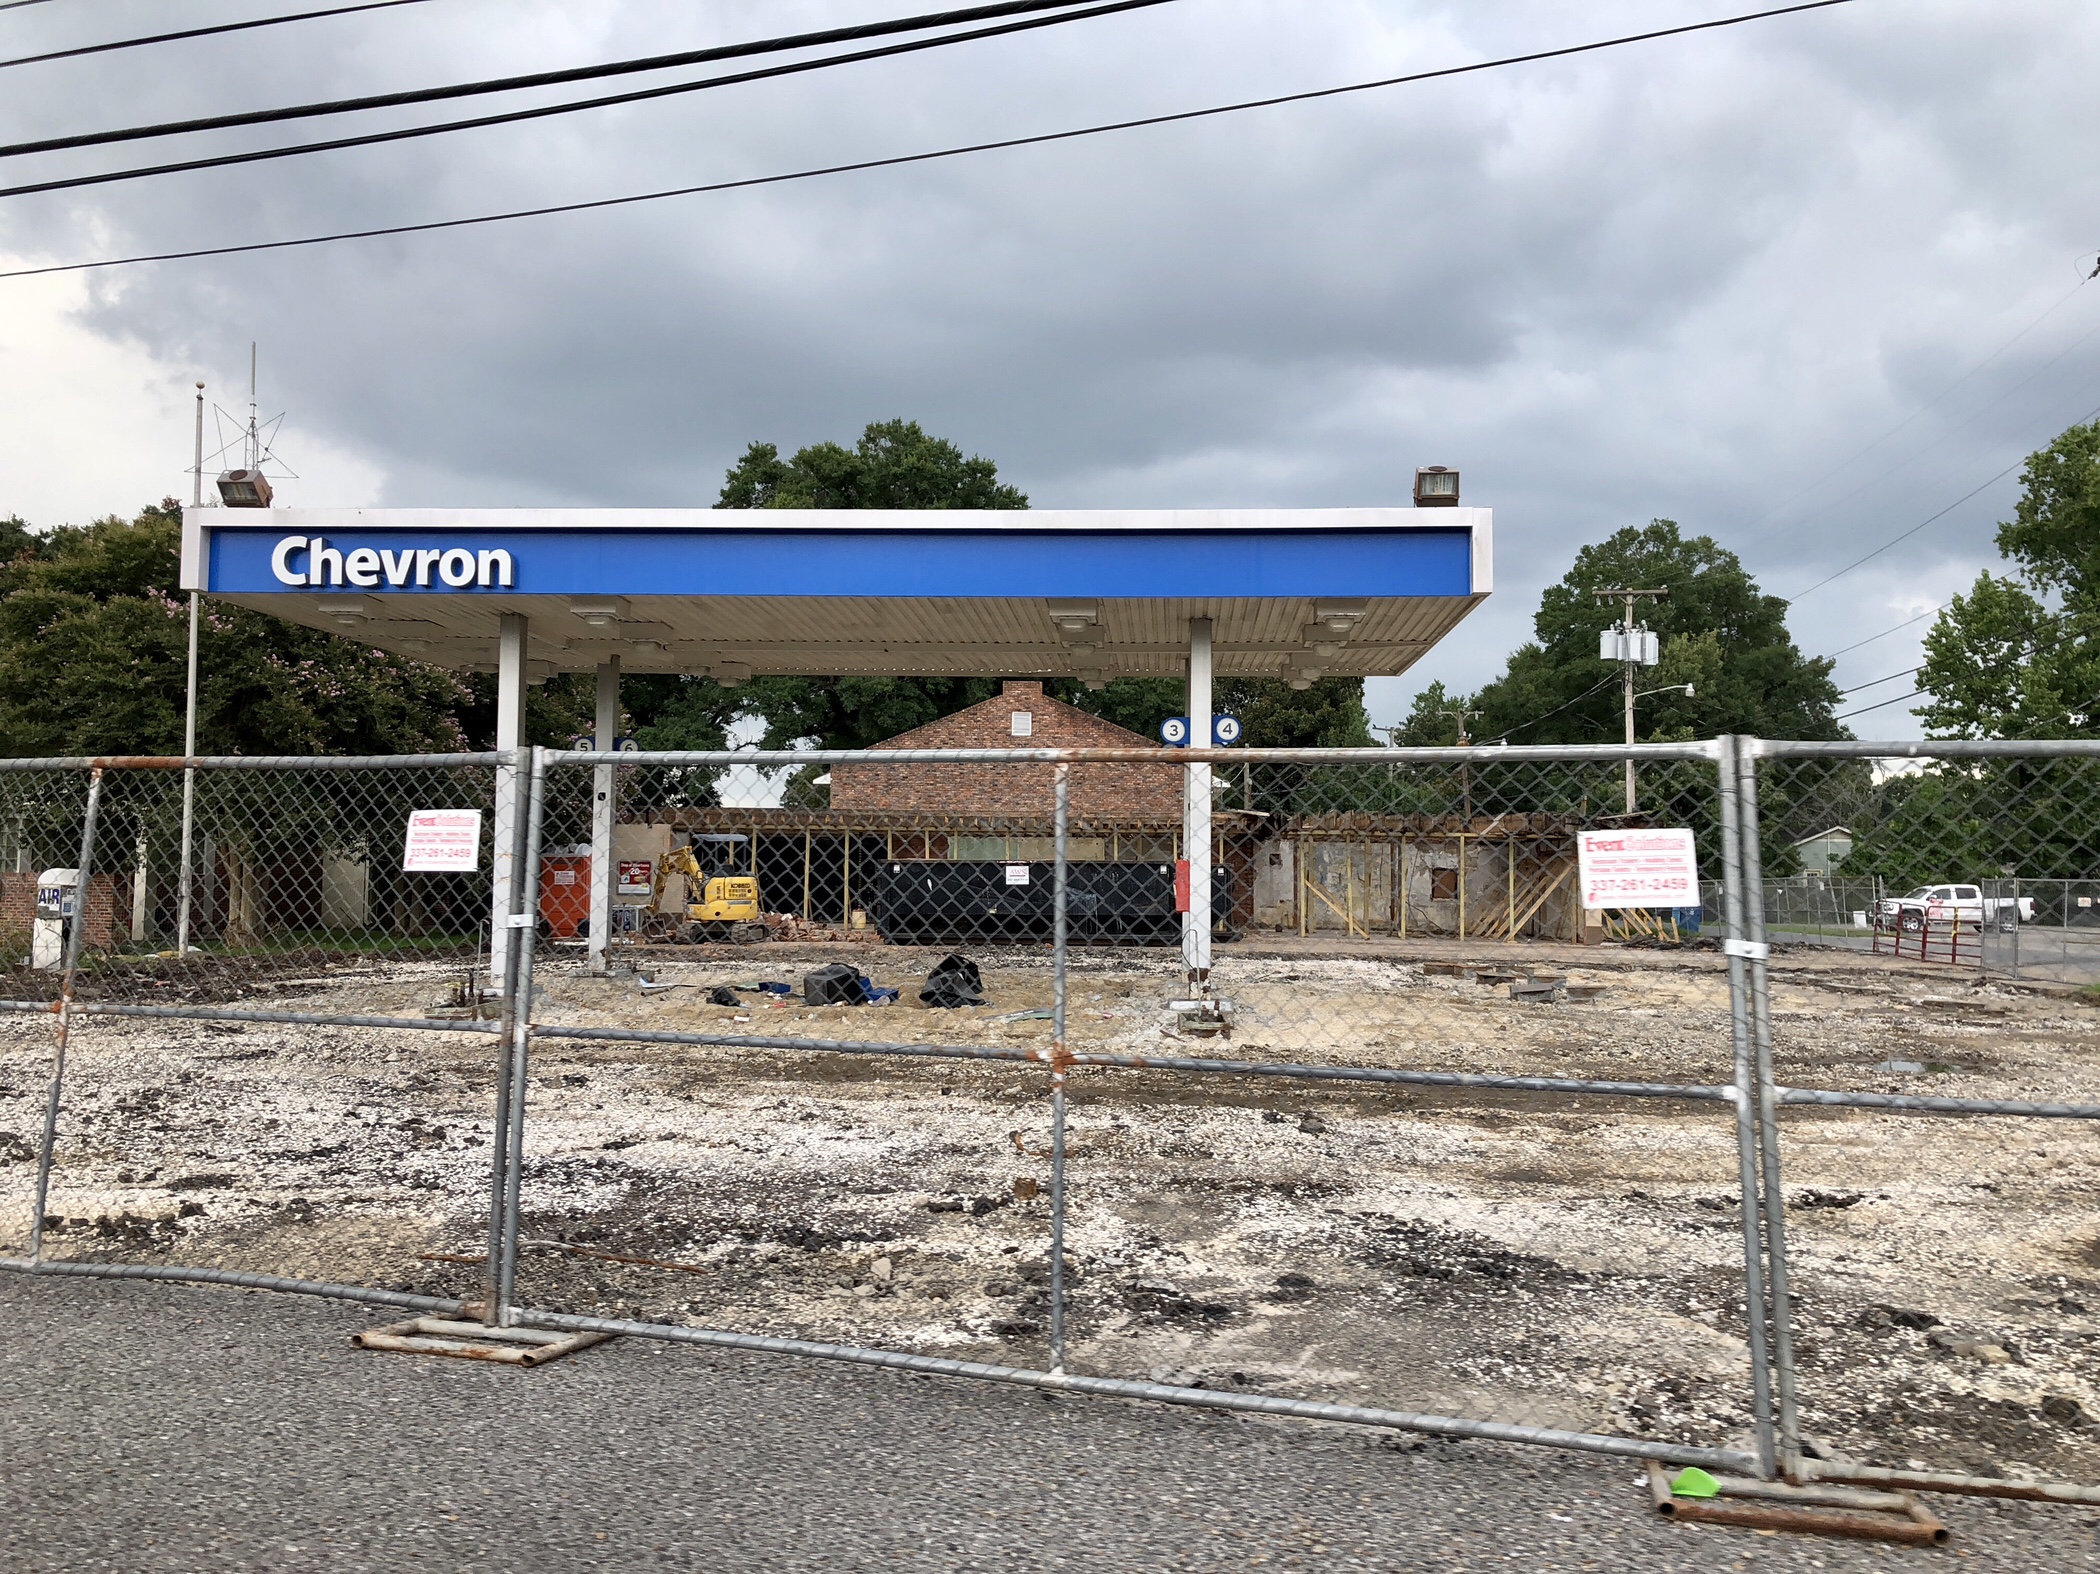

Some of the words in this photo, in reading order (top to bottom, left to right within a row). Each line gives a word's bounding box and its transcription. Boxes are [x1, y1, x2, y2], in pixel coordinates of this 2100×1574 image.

[271, 535, 512, 587] Chevron
[1169, 724, 1179, 737] 3
[1222, 722, 1233, 735] 4
[580, 742, 588, 751] 5
[410, 848, 471, 858] 337-261-2459
[1590, 878, 1688, 891] 337-261-2459
[38, 888, 60, 904] AIR
